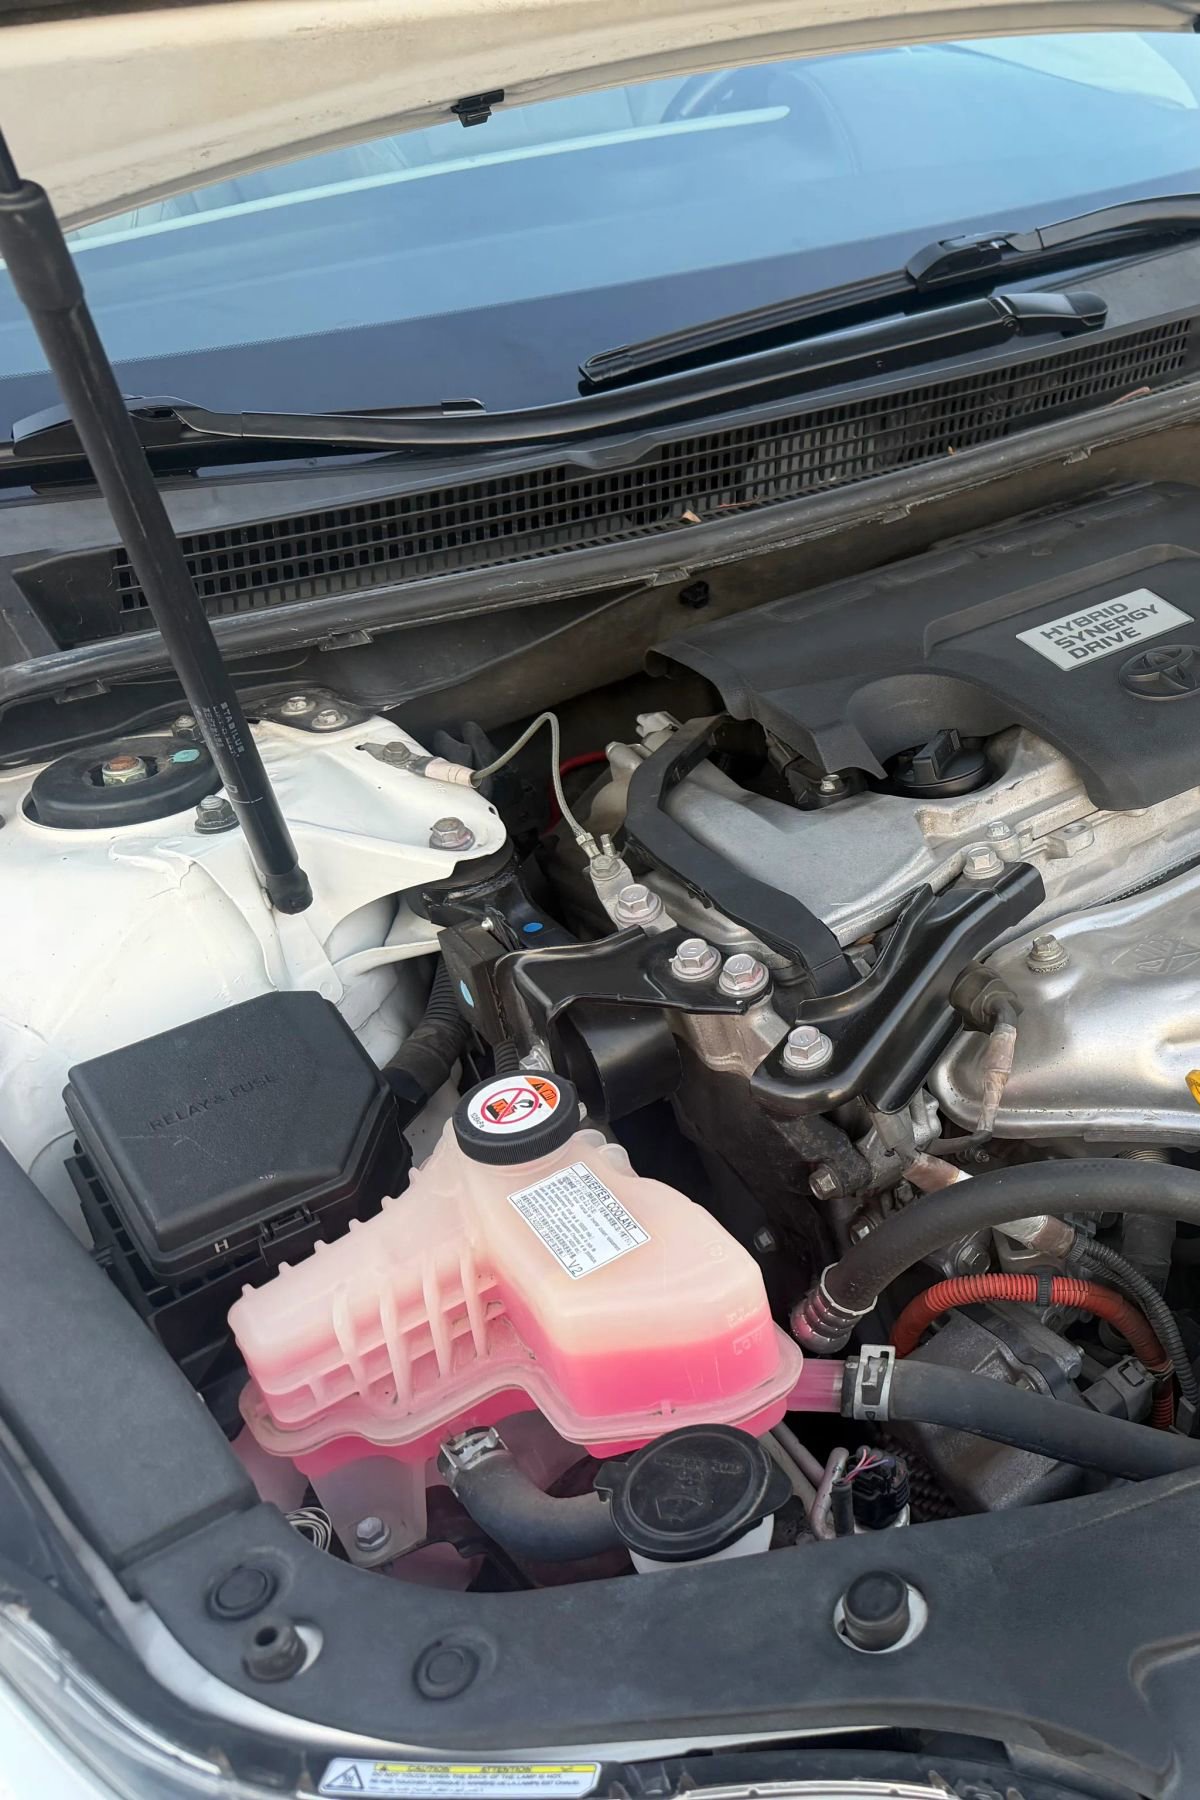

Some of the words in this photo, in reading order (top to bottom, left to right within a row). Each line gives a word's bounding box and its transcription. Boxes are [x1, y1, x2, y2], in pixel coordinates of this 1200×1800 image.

[1040, 603, 1128, 639] HYBRID
[1054, 604, 1159, 649] SYNERGY
[1068, 627, 1141, 659] DRIVE
[221, 702, 245, 753] STABILUS
[149, 1098, 209, 1131] RELAY
[581, 1173, 611, 1202] INVERTER
[607, 1202, 637, 1232] COOLANT
